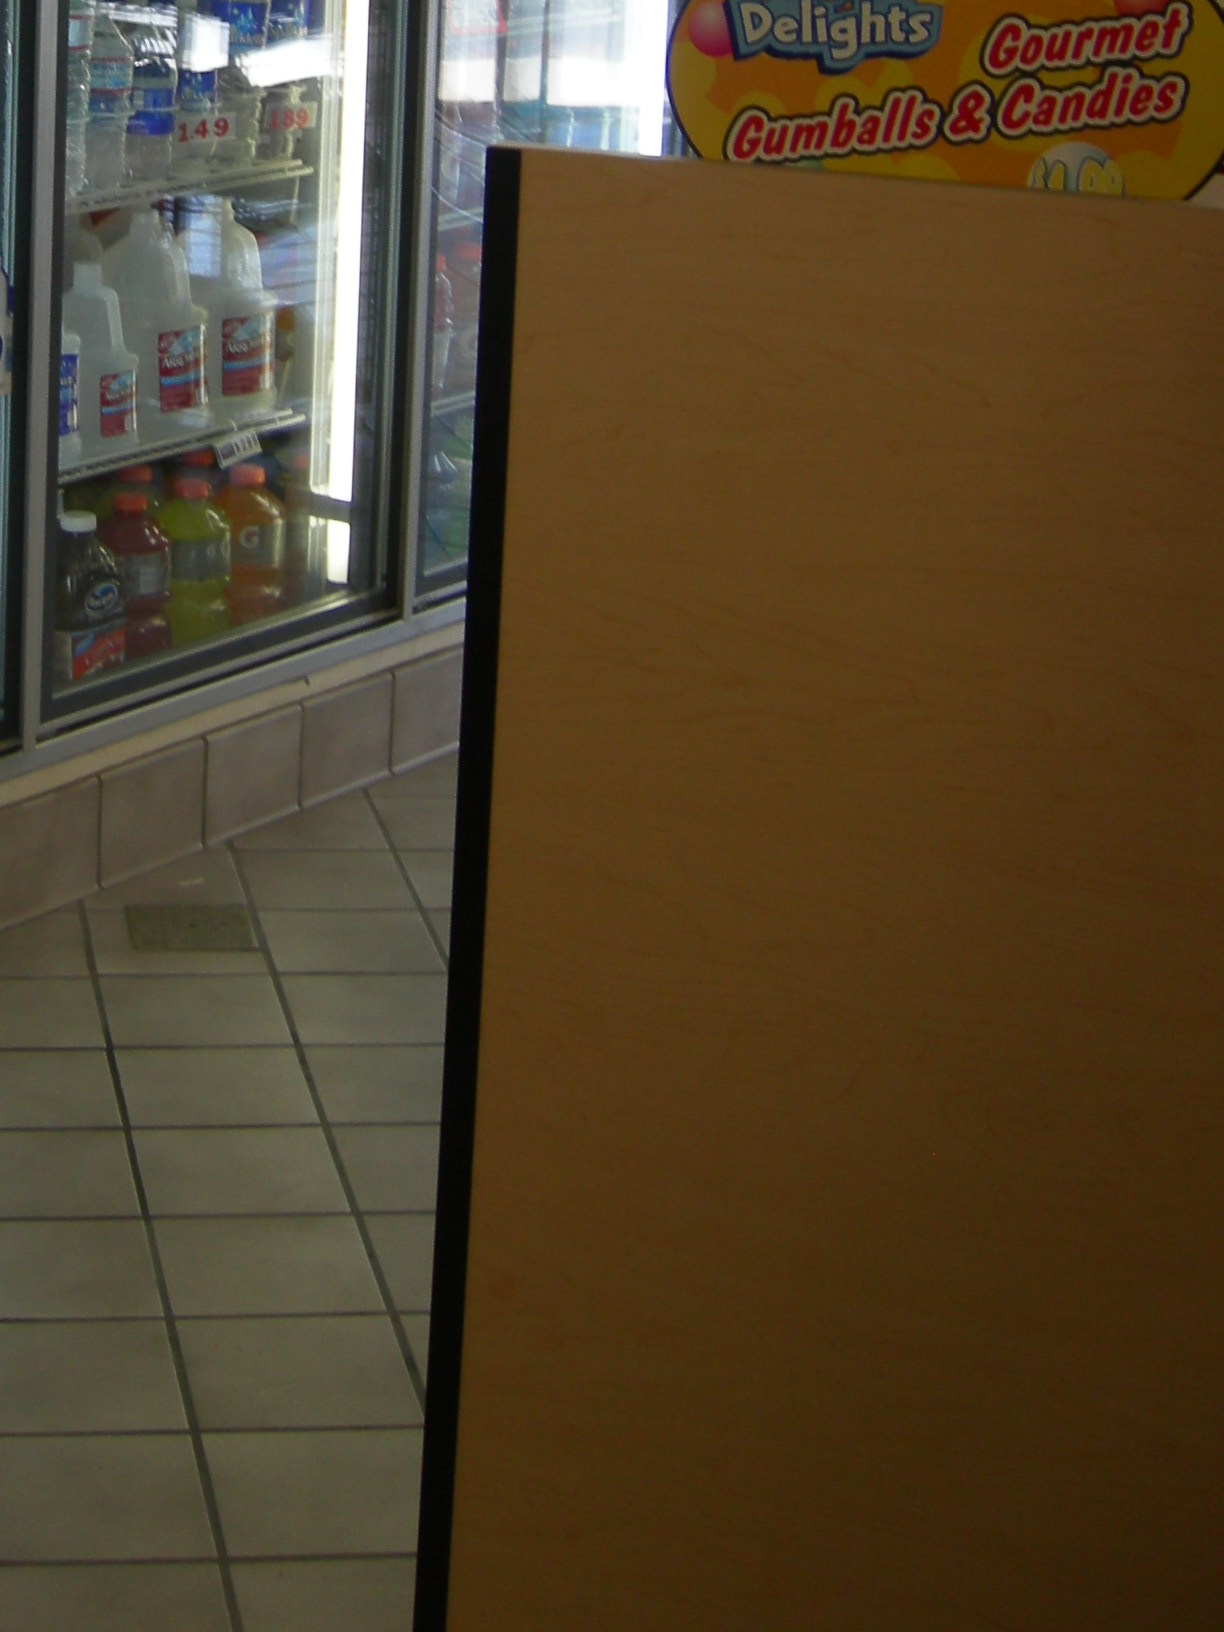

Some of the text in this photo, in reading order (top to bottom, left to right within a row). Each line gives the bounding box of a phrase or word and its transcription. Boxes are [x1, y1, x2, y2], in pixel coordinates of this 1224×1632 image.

[986, 6, 1188, 72] Gourmet
[731, 68, 1181, 162] Gumballs & Candies
